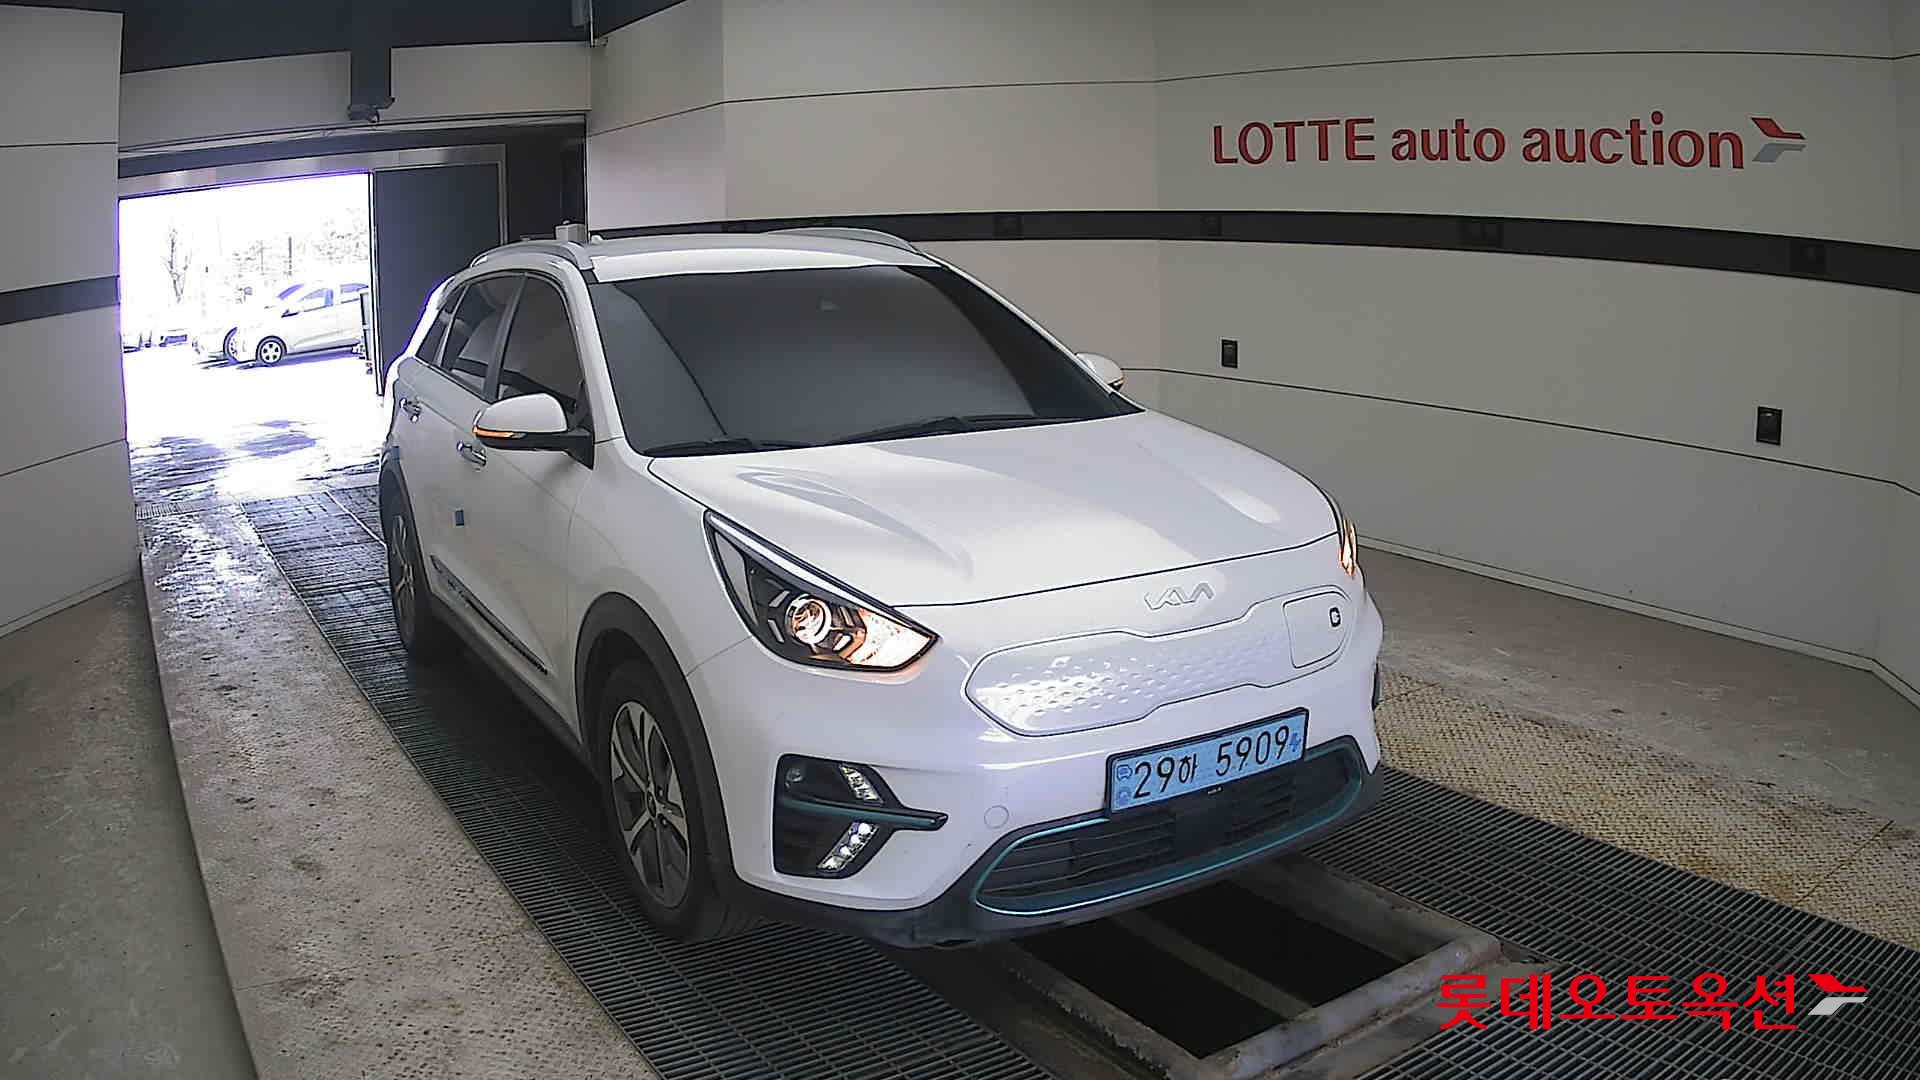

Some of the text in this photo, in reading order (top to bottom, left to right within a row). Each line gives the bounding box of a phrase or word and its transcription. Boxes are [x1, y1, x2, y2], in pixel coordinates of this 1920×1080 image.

[1213, 111, 1745, 169] LOTTE auto auction
[1133, 725, 1290, 799] 29하 5909
